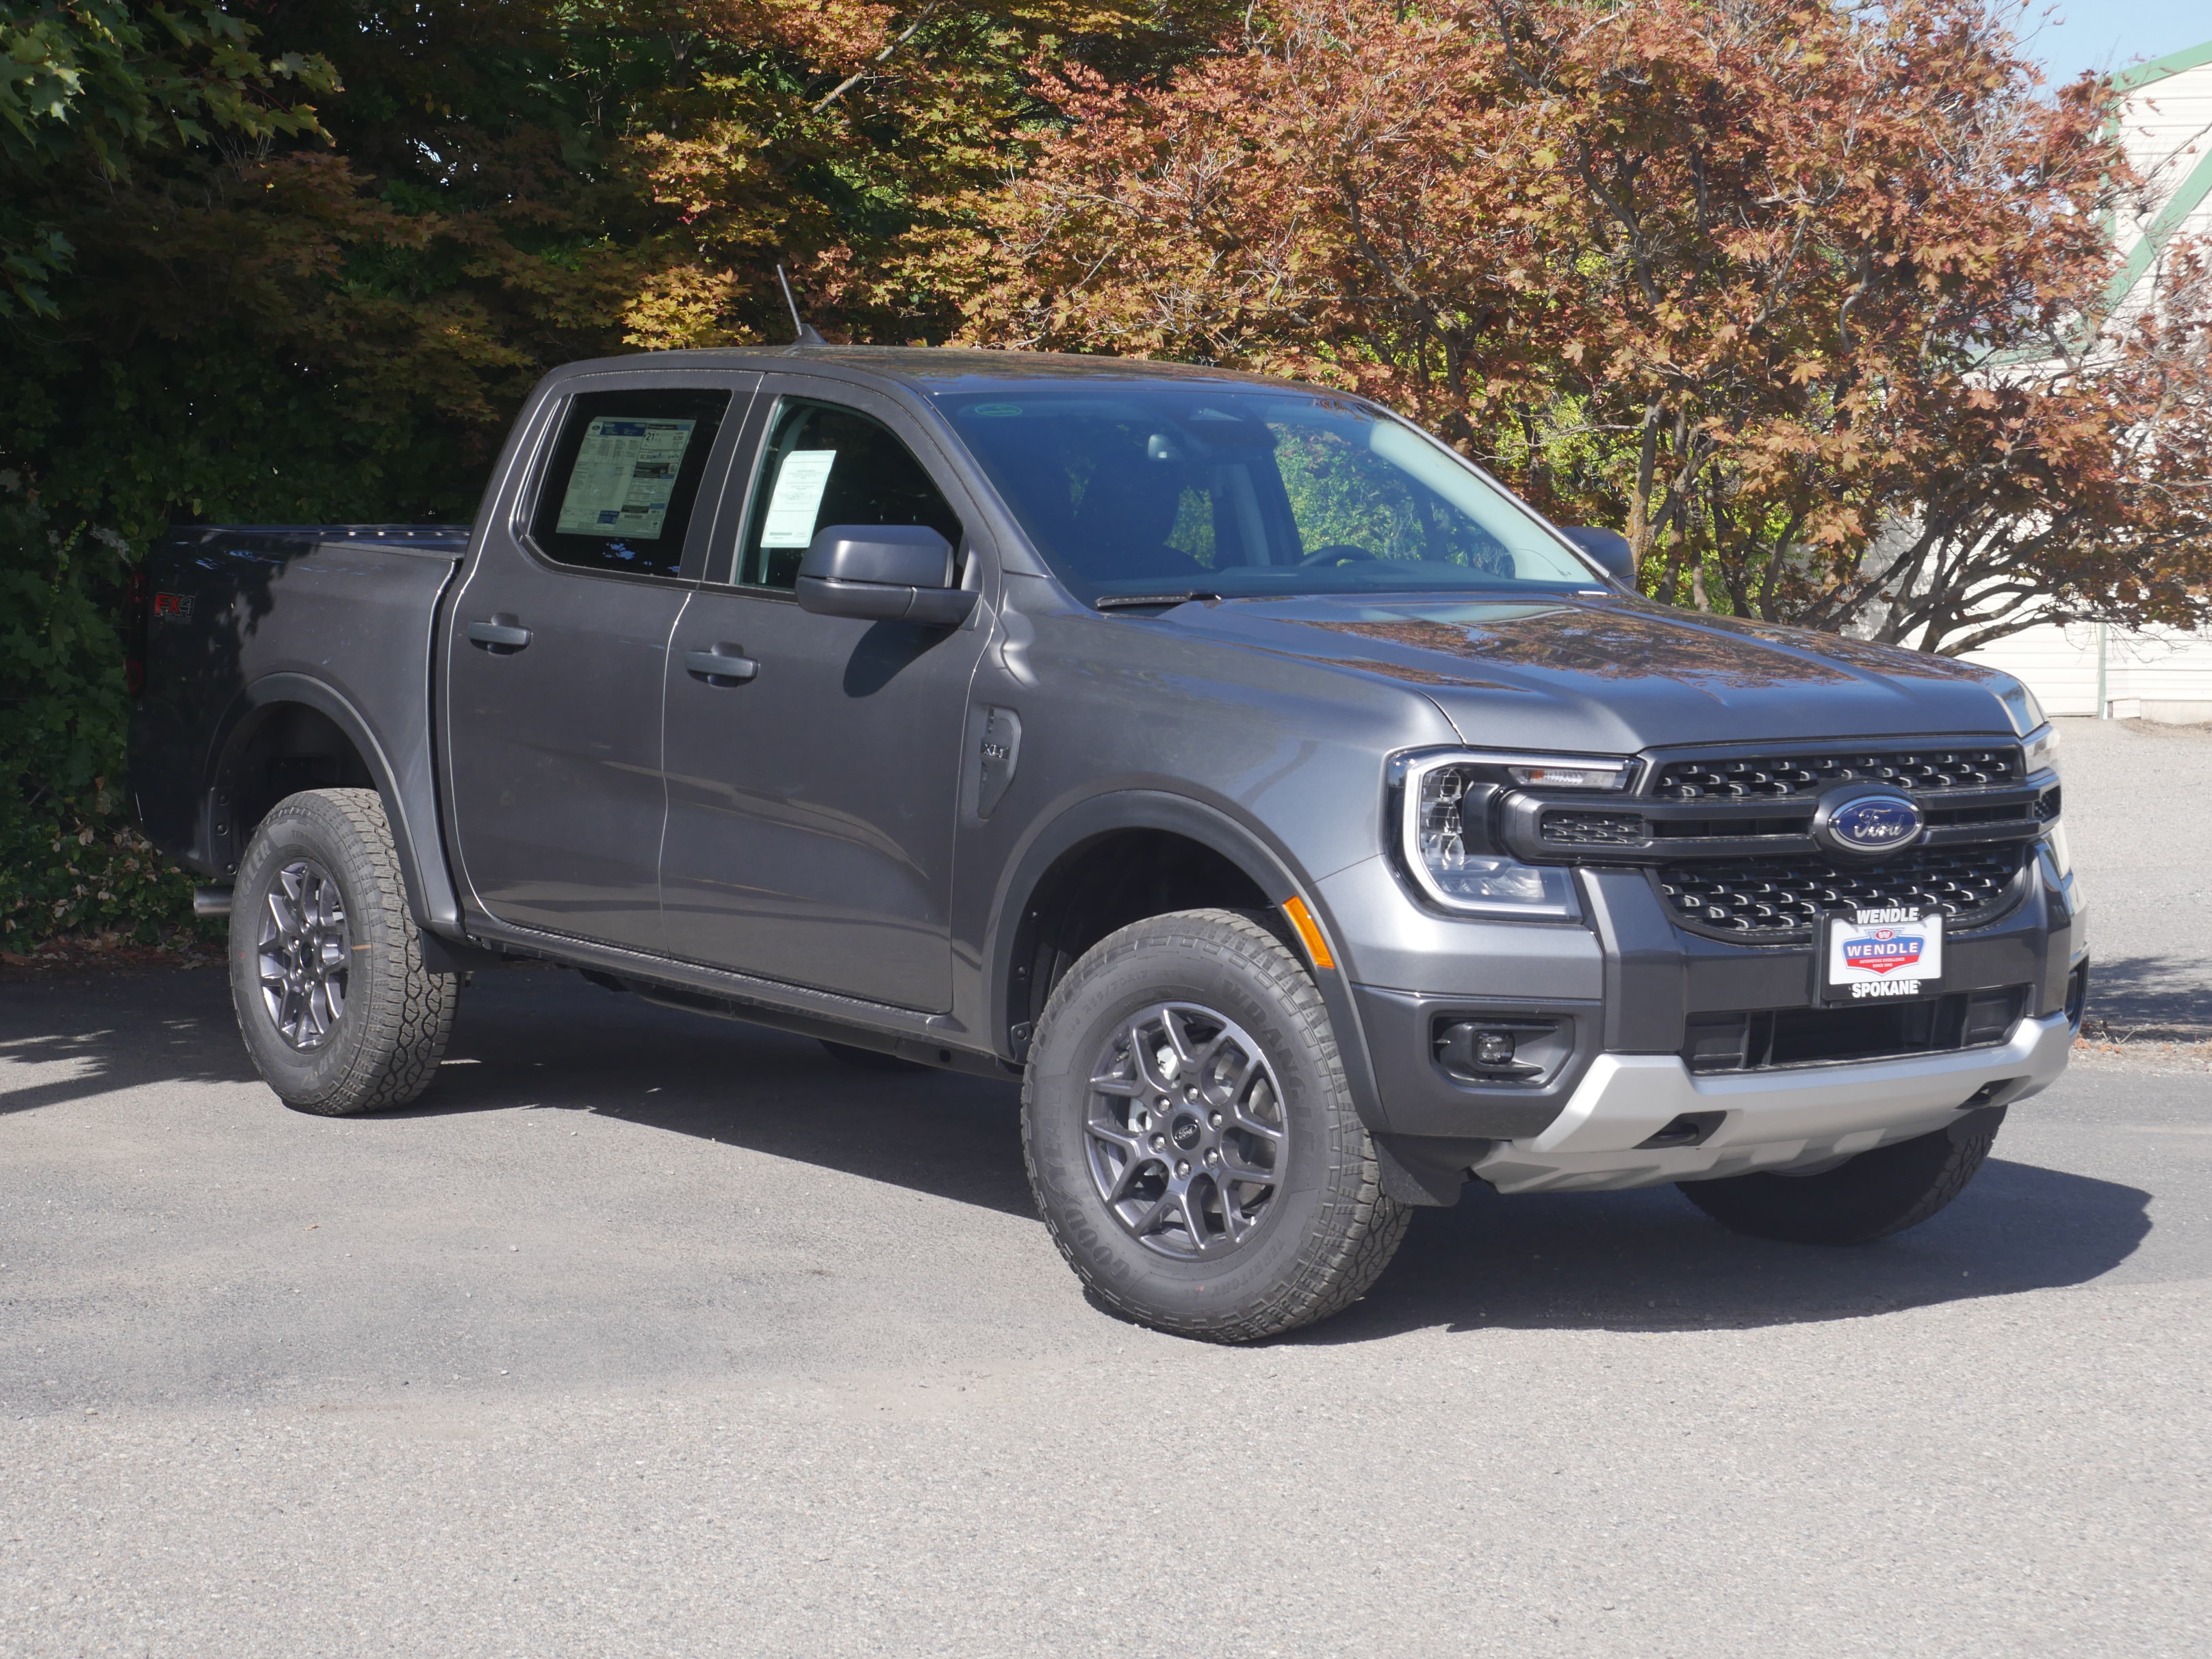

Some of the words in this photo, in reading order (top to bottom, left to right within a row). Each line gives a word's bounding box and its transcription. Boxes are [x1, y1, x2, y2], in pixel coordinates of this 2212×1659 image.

[154, 592, 196, 617] FX4
[983, 743, 1009, 758] XLT
[1853, 808, 1904, 838] Ford
[1856, 908, 1919, 925] WENDLE
[1847, 942, 1918, 957] WENDLE
[1851, 980, 1919, 999] SPOKANE
[1222, 978, 1315, 1181] WRANGLER
[1178, 1128, 1193, 1139] Ford
[1040, 1083, 1131, 1278] GOODYEAR
[1211, 1237, 1287, 1298] TERRITORY
